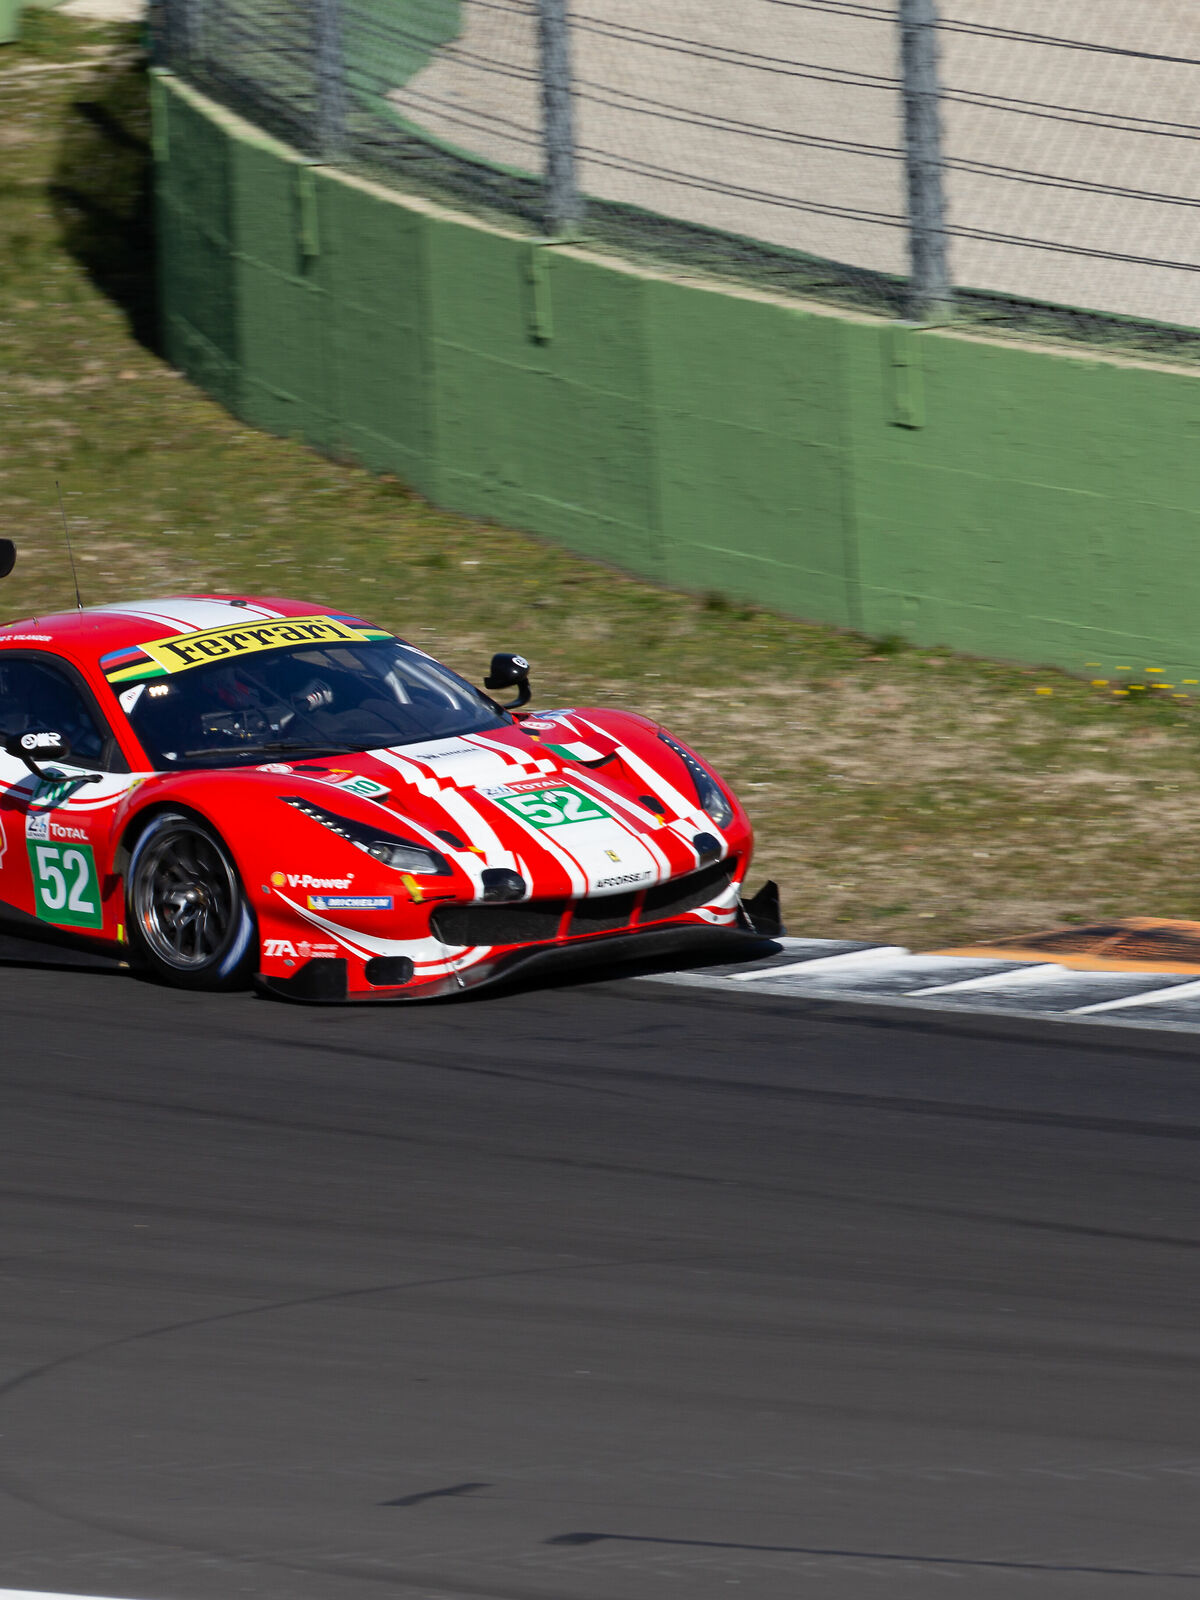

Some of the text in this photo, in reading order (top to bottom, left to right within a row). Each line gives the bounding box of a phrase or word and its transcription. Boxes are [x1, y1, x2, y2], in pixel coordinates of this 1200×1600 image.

[159, 619, 351, 665] Ferrari
[509, 780, 564, 791] TOTAL
[504, 790, 604, 824] 52
[49, 822, 89, 840] TOTAL
[36, 845, 95, 914] 52
[287, 874, 352, 889] V-Power
